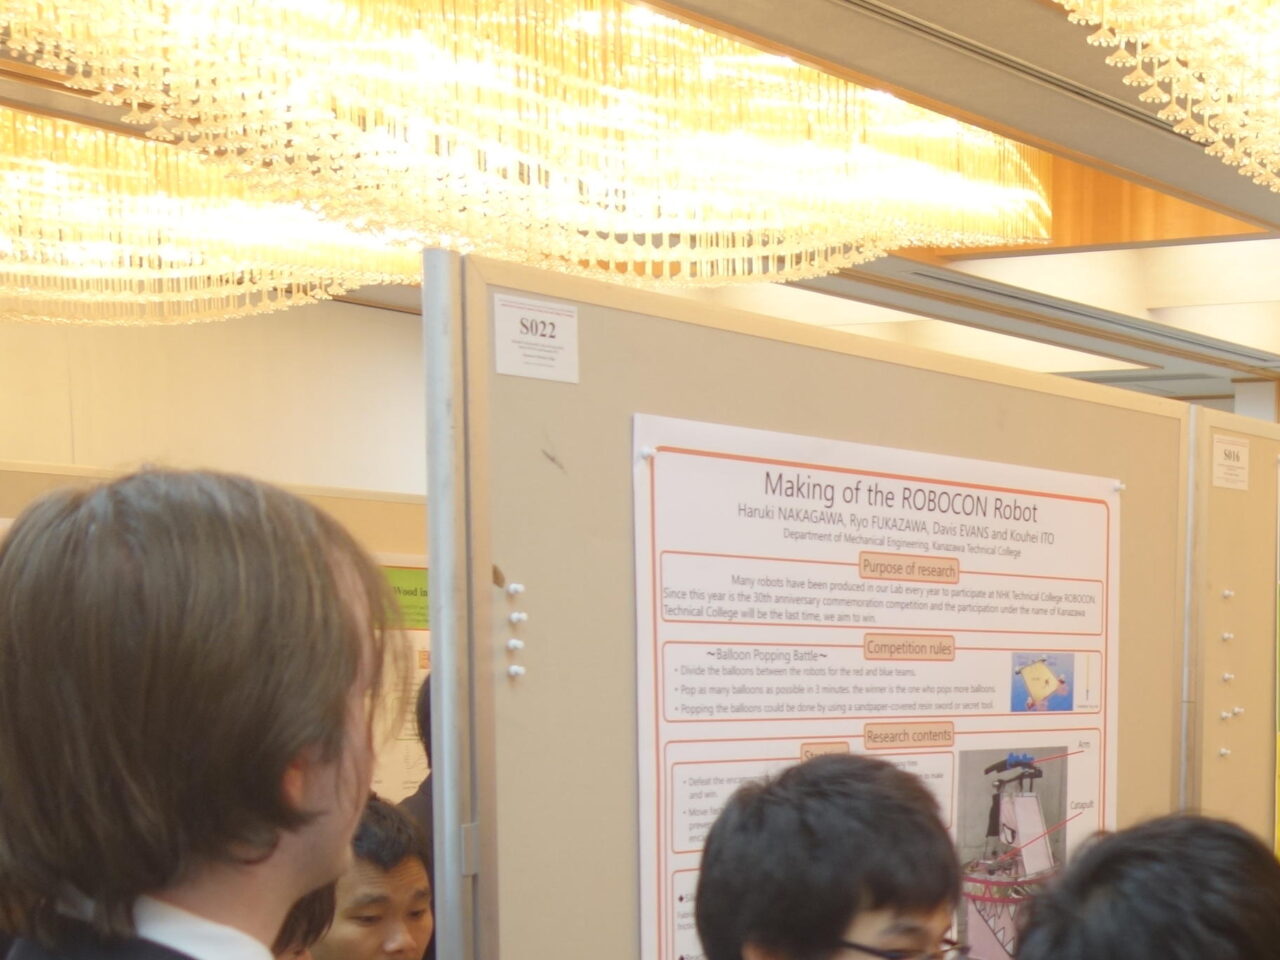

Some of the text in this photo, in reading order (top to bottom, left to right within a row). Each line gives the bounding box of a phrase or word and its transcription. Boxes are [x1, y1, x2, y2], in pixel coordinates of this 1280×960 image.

[520, 317, 556, 338] S022
[764, 472, 1038, 523] Making of the ROBOCON Robot
[738, 503, 774, 519] Haruki
[850, 513, 868, 531] Ryo
[933, 521, 957, 536] Davis
[959, 525, 989, 538] EVANS
[992, 530, 1007, 540] and
[1010, 531, 1038, 543] Kouhei
[1040, 532, 1054, 544] ITO
[783, 528, 832, 541] Department
[834, 533, 843, 542] of
[844, 533, 886, 547] Mechanical
[932, 541, 965, 553] Kanazawa
[967, 544, 996, 556] Technical
[998, 545, 1021, 559] College
[863, 559, 956, 577] Purpose of research
[393, 586, 417, 597] Wood
[664, 588, 687, 599] Since
[689, 588, 705, 600] this
[708, 592, 726, 603] year
[736, 591, 751, 602] the
[753, 592, 772, 602] 30th
[774, 594, 820, 607] anniversary
[822, 597, 884, 607] commemoration
[885, 599, 928, 611] competition
[930, 601, 943, 611] and
[944, 601, 956, 611] the
[957, 603, 999, 614] participation
[1000, 605, 1018, 614] under
[1019, 606, 1030, 615] the
[1057, 608, 1086, 616] Kanazawa
[664, 604, 850, 622] Technical College will be the last aim
[753, 649, 791, 664] Popping
[867, 641, 952, 656] Competition rules
[866, 729, 952, 744] Research contents
